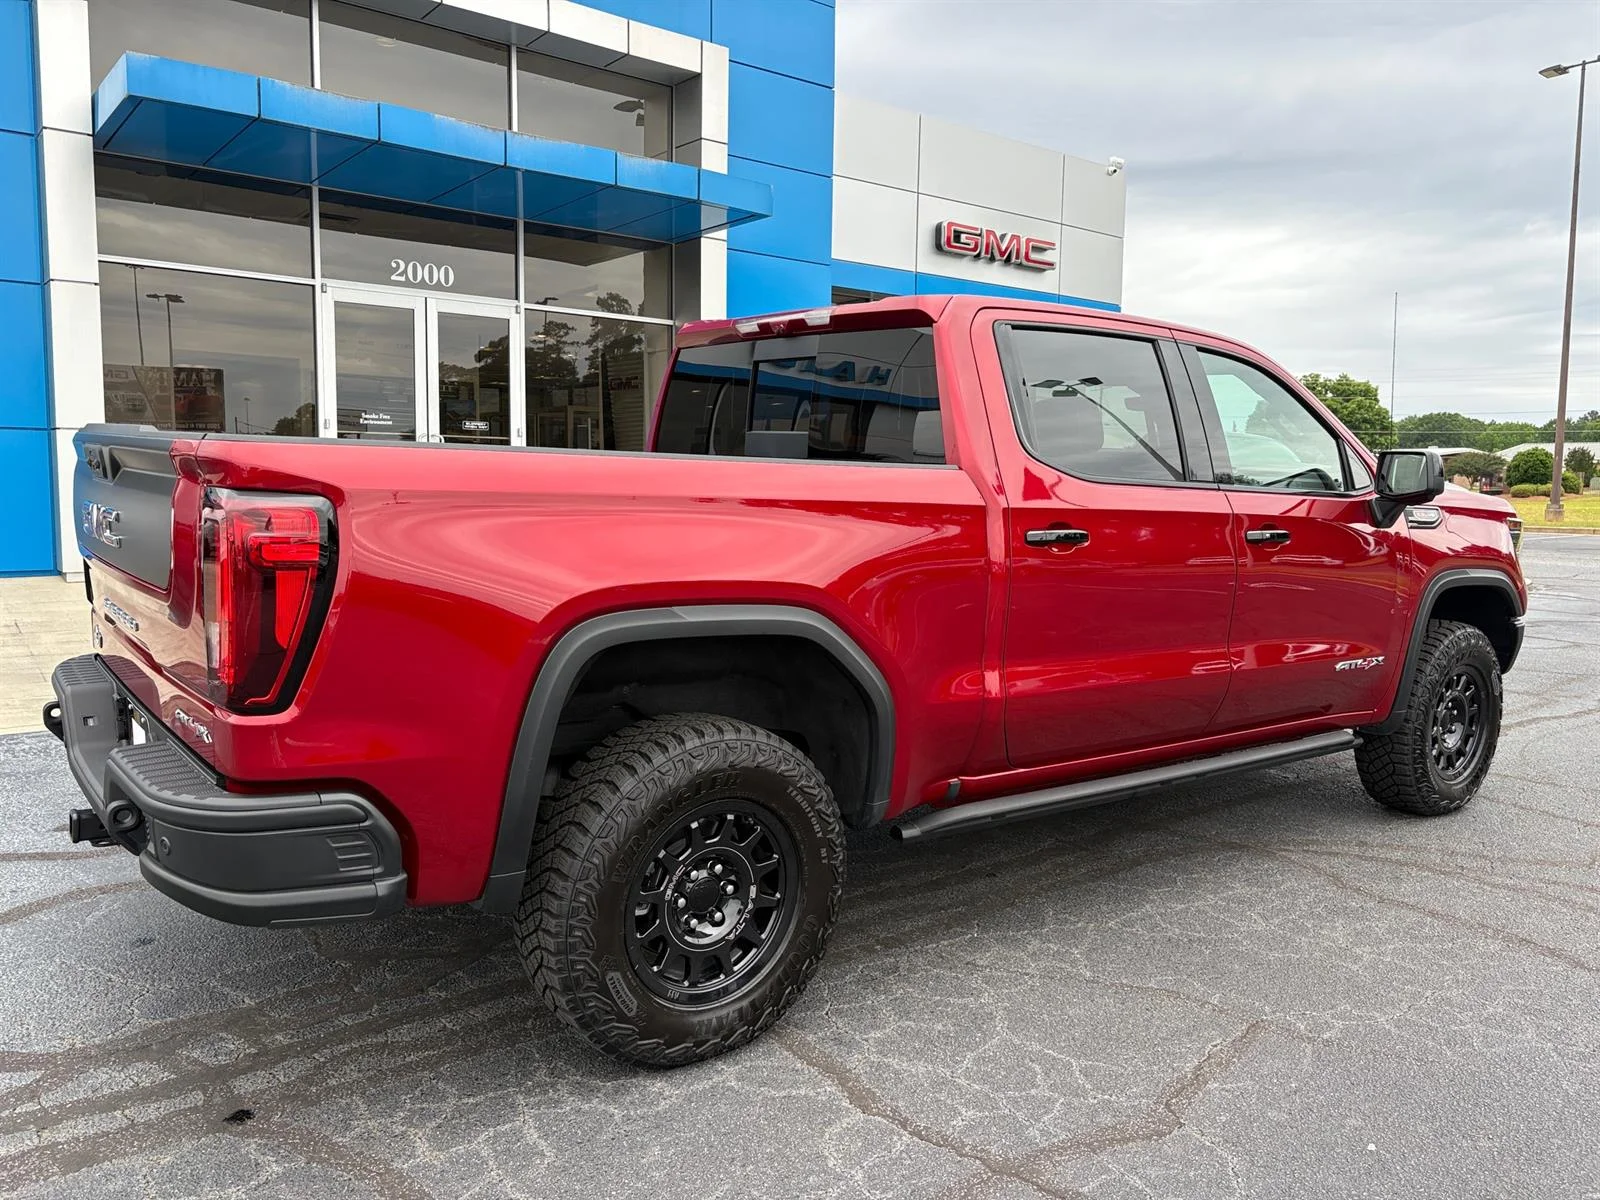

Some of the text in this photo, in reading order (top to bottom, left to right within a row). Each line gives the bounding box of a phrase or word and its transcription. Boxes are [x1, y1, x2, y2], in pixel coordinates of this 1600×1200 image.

[941, 220, 1057, 269] GMC
[390, 258, 455, 288] 2000
[787, 786, 823, 838] TERRITORY
